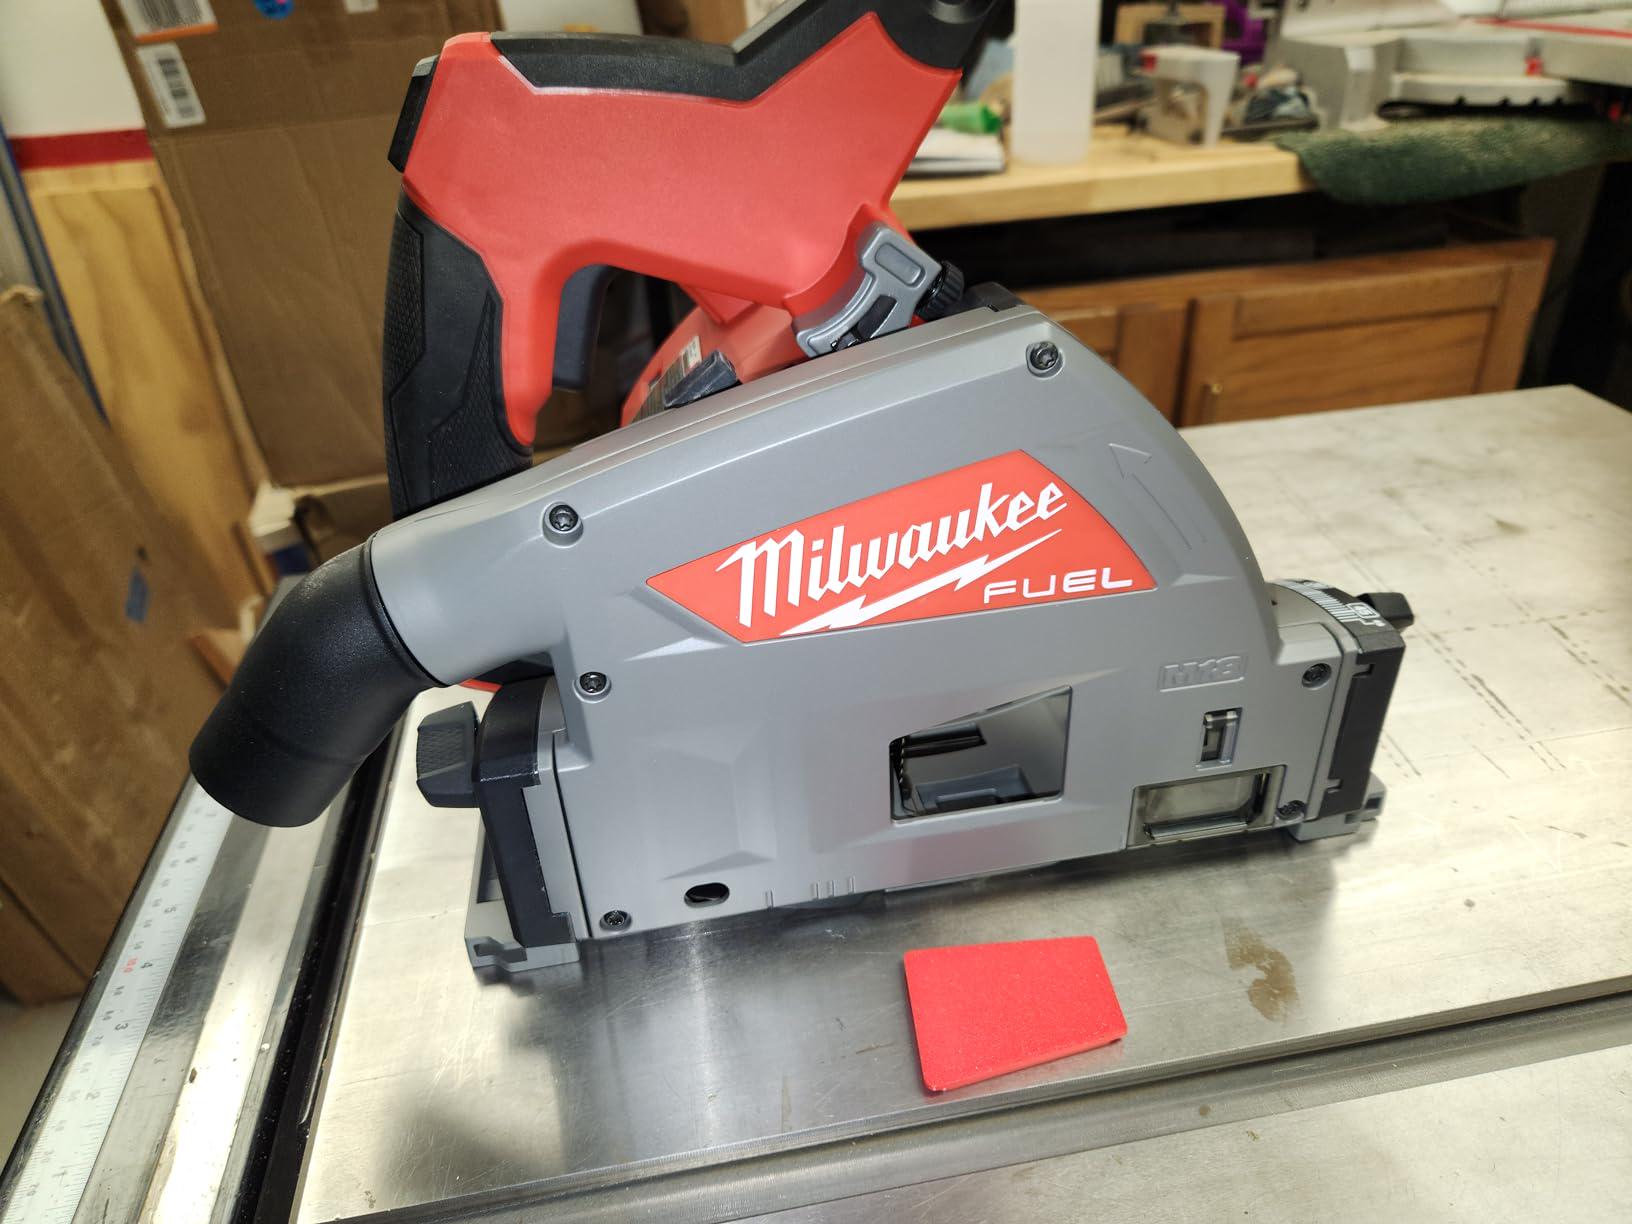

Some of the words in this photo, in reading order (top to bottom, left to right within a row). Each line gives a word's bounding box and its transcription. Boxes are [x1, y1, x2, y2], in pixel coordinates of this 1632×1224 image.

[716, 482, 1067, 627] Milwaukee
[984, 568, 1132, 604] FUEL
[114, 1022, 129, 1031] 3
